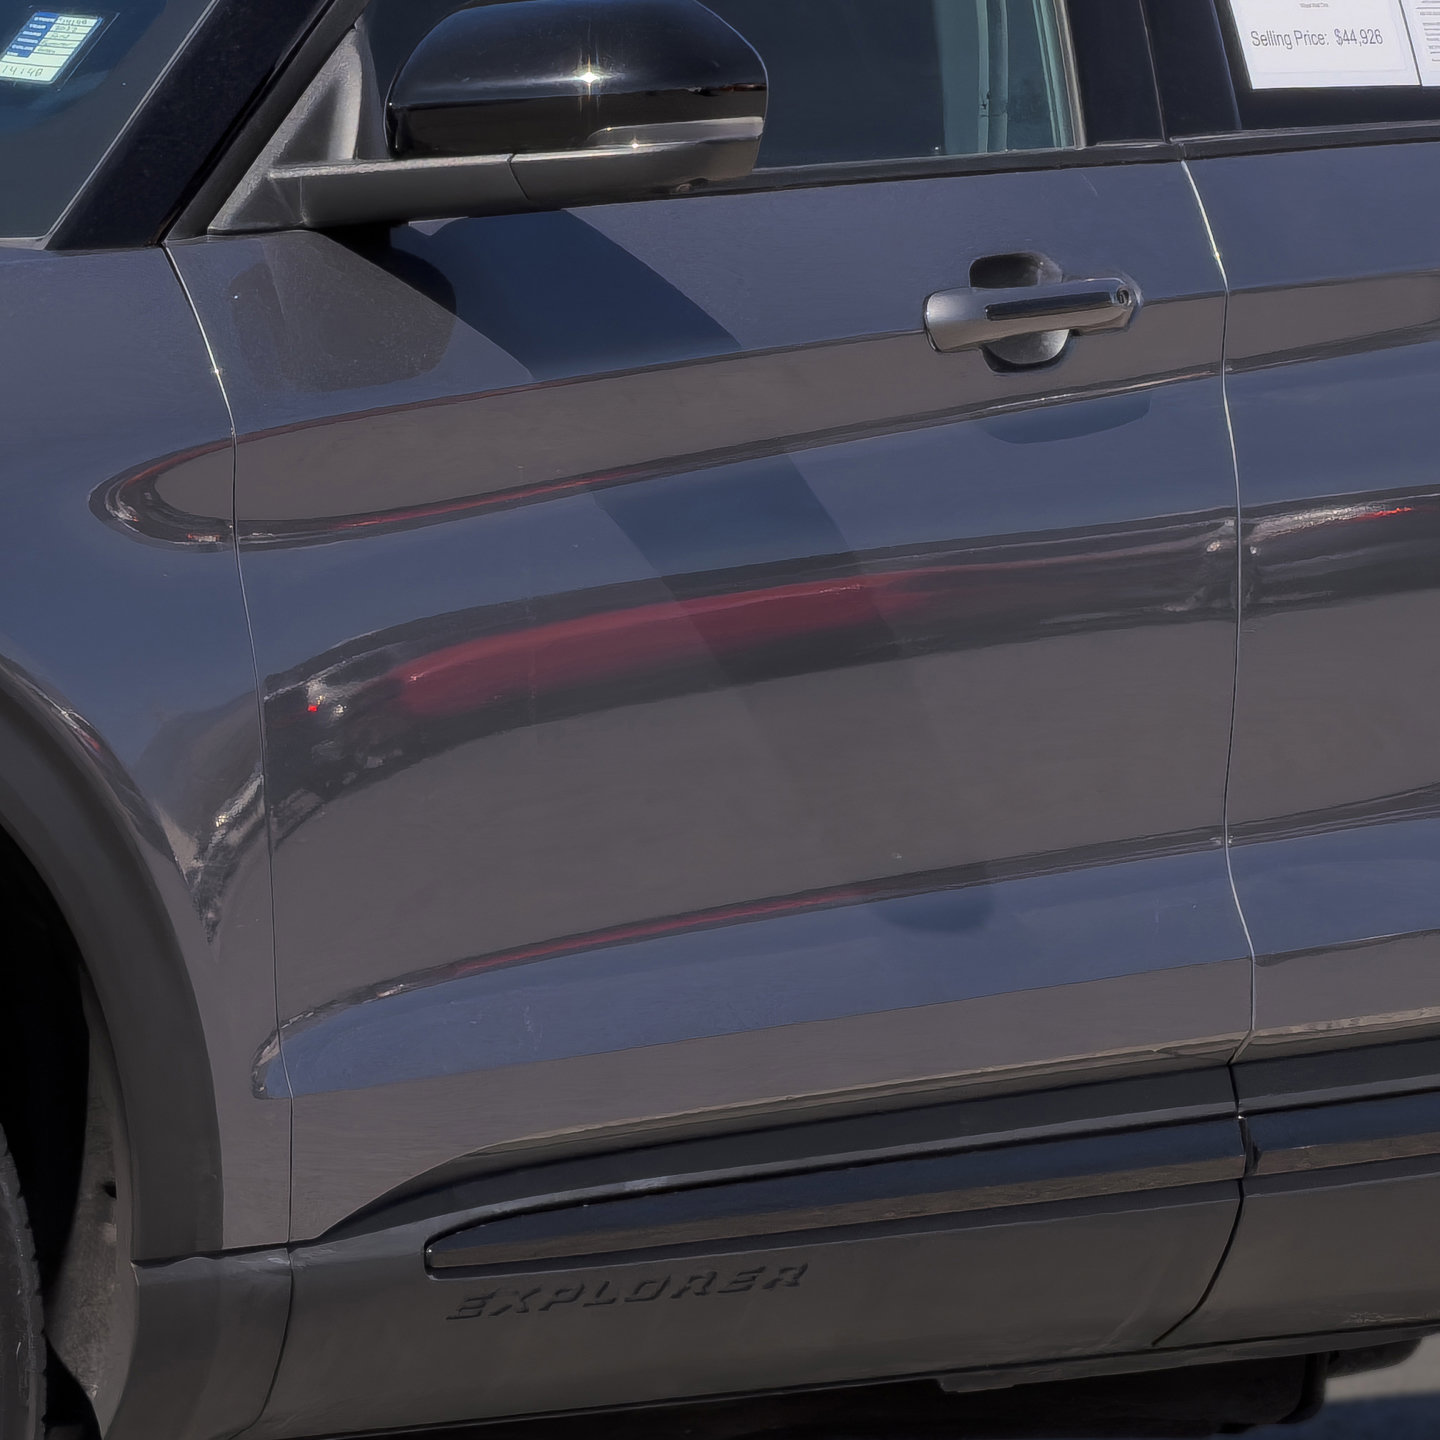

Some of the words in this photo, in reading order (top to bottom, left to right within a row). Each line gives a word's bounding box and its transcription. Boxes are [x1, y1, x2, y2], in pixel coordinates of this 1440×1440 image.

[1251, 30, 1292, 49] Selling
[1294, 30, 1329, 46] Price:
[1334, 28, 1384, 47] $44,926
[446, 1262, 809, 1320] EXPLORER
